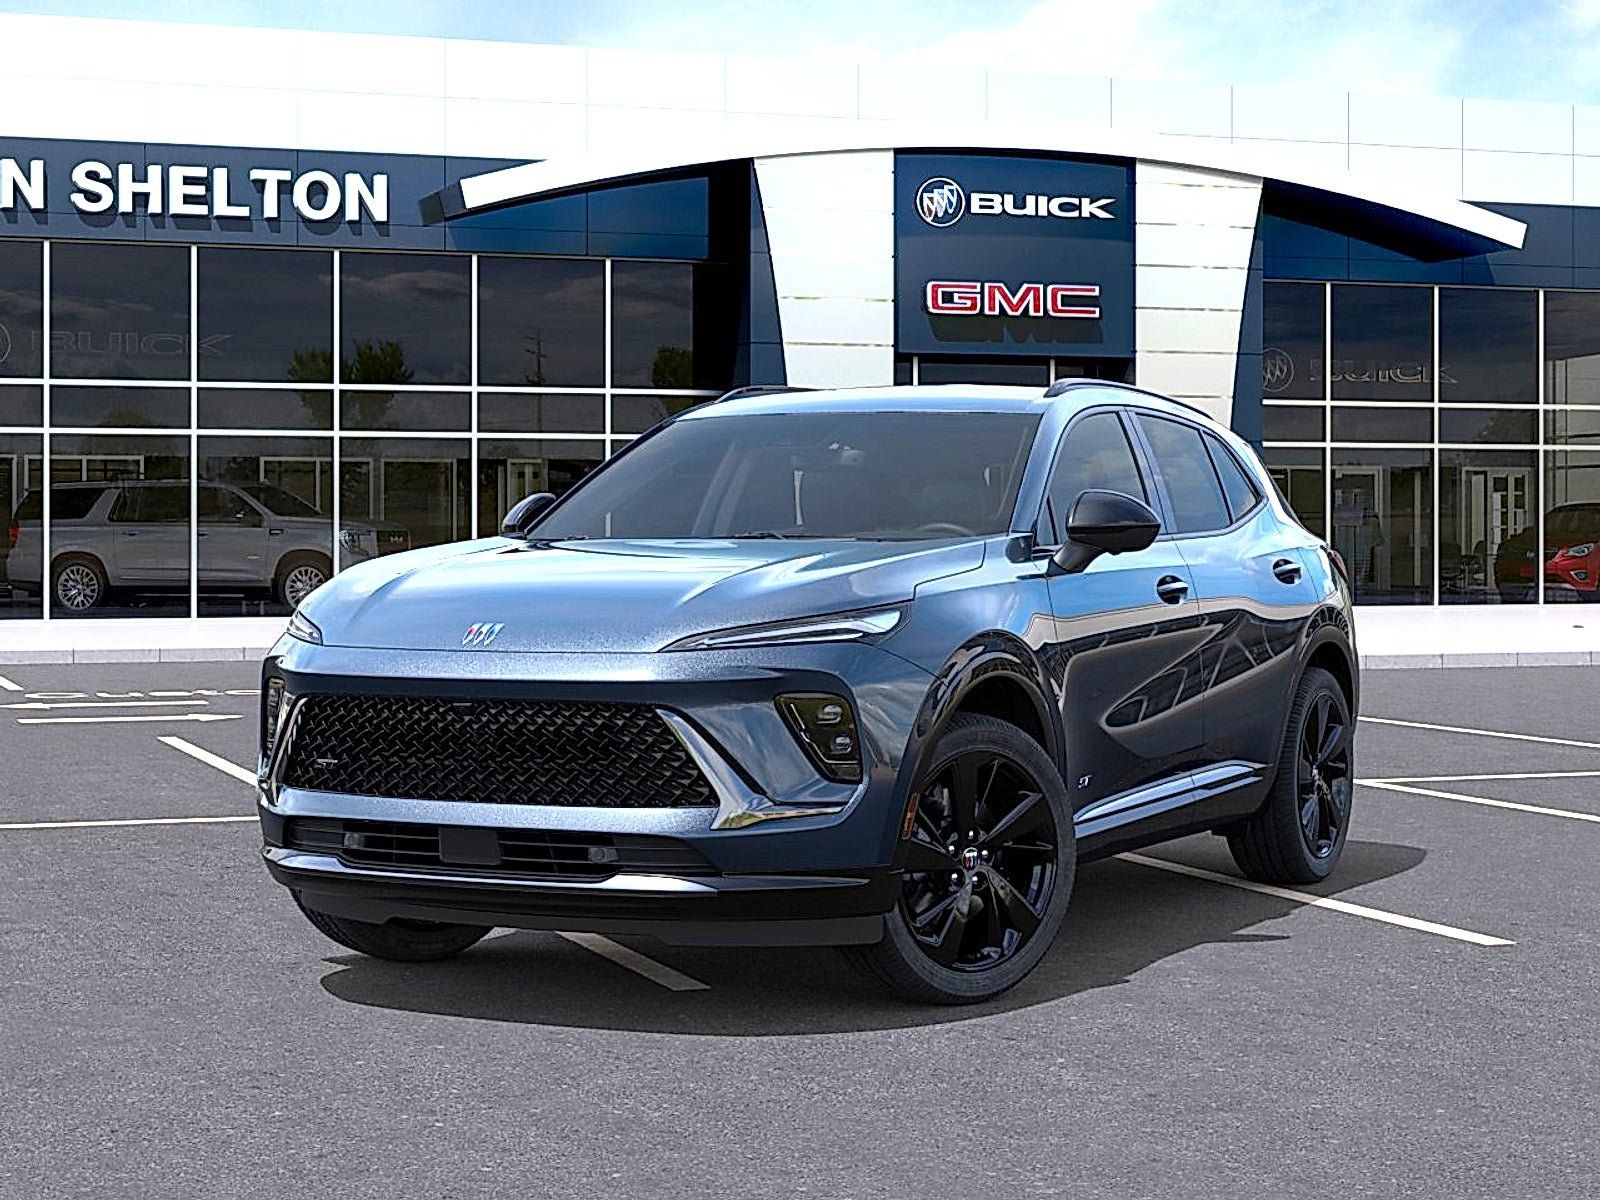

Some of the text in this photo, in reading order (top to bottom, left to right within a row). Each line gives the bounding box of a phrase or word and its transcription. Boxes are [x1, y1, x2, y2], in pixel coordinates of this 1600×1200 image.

[69, 160, 388, 223] SHELTON
[970, 192, 1117, 219] BUICK
[926, 280, 1101, 319] GMC
